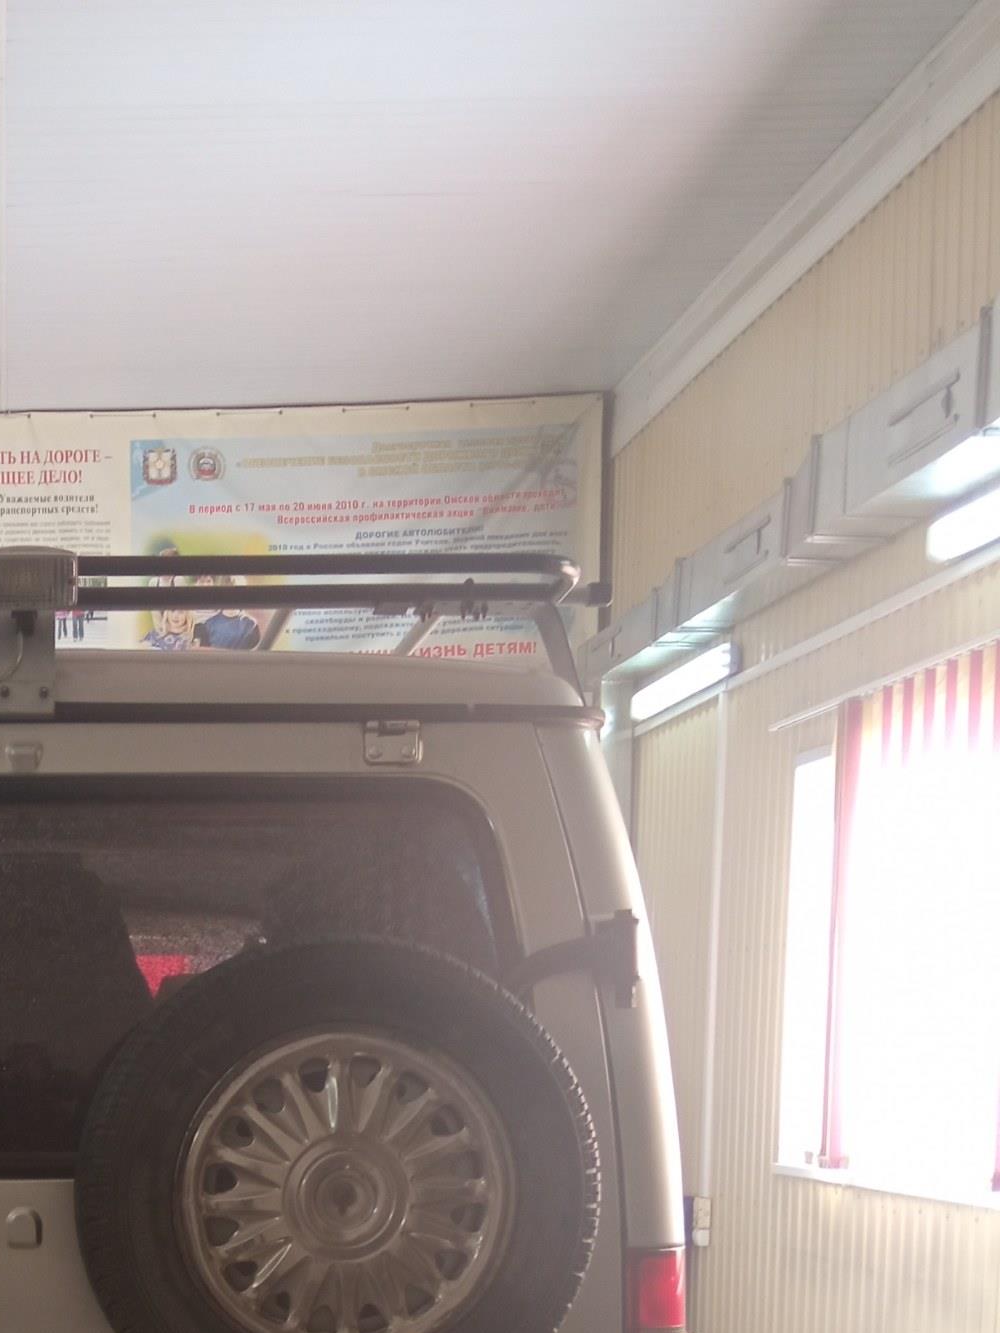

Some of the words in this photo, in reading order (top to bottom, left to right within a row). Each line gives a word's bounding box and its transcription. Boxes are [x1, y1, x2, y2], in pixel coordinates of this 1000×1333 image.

[20, 450, 41, 465] НА
[43, 449, 101, 466] ДОРОГЕ
[38, 469, 83, 485] ДЕЛО!
[0, 494, 52, 504] Уважаемые
[54, 494, 95, 503] водители
[189, 504, 196, 514] В
[198, 504, 233, 515] период
[244, 502, 255, 512] 17
[258, 504, 276, 512] мая
[279, 503, 290, 511] по
[293, 501, 305, 511] 20
[335, 500, 359, 511] 2010
[372, 500, 384, 509] на
[387, 498, 441, 509] территории
[444, 495, 480, 505] Омской
[61, 503, 99, 516] средств!
[277, 515, 350, 526] Всероссийская
[352, 510, 444, 523] профилактическая
[355, 530, 400, 541] ДОРОГИЕ
[419, 645, 467, 659] ИЗНЬ
[473, 641, 537, 658] ДЕТЯМ!
